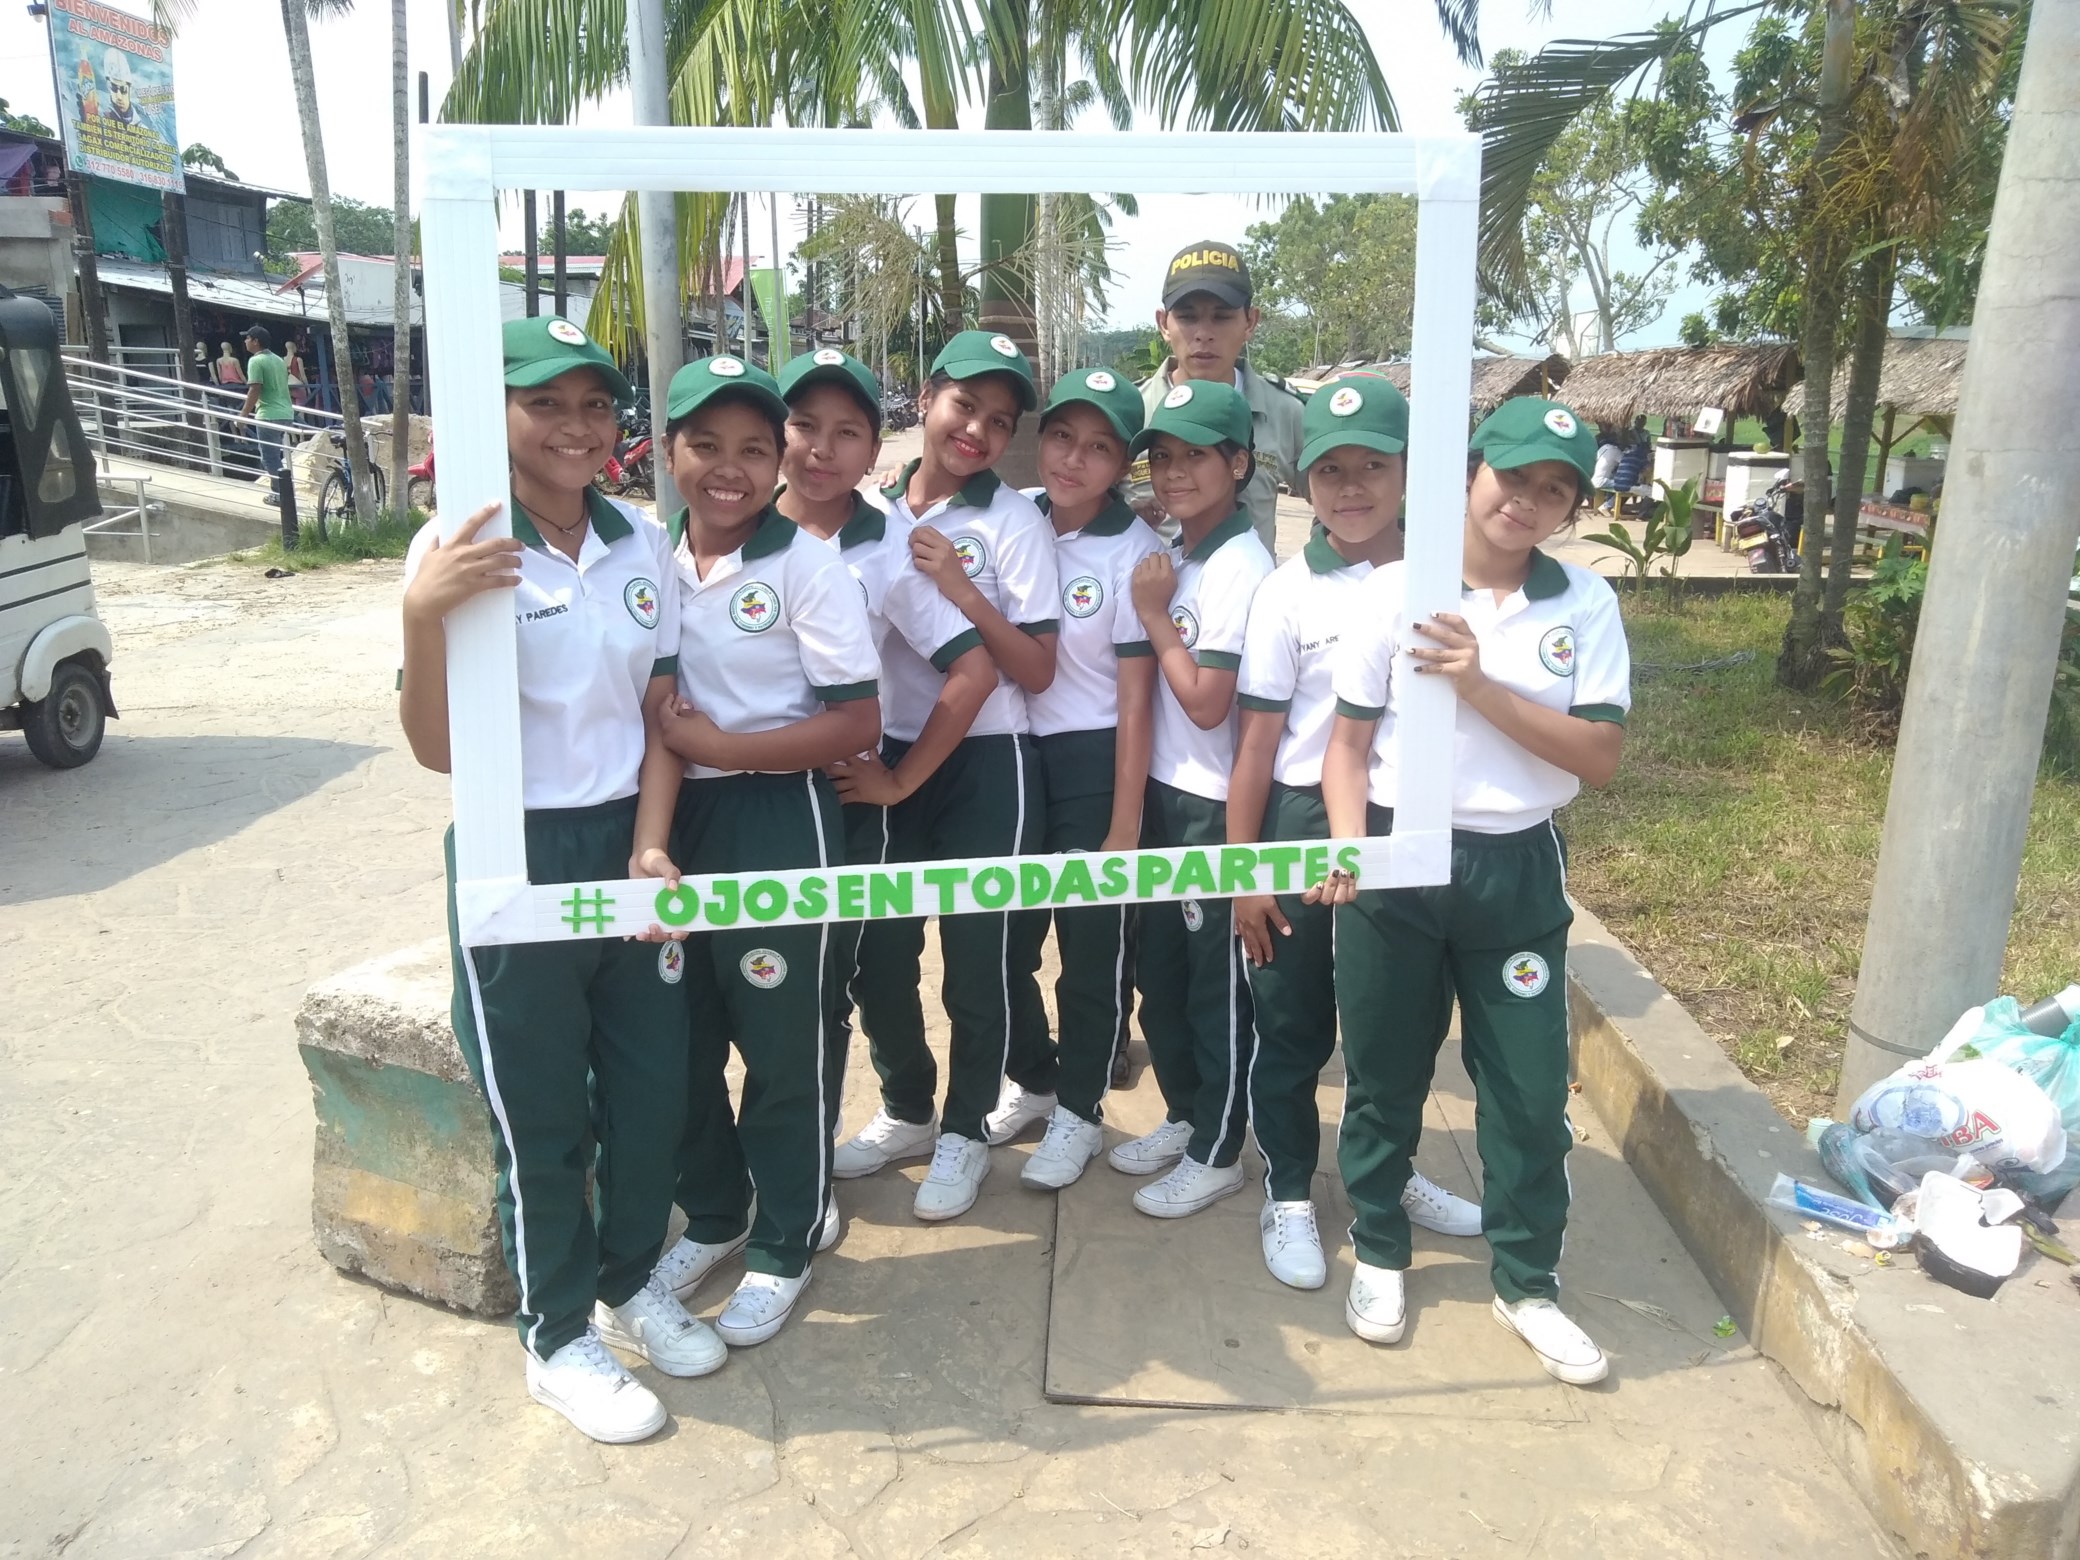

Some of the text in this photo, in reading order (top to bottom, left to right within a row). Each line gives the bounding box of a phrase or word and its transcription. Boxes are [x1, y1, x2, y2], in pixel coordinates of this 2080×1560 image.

[54, 0, 169, 47] BIENVENIDOS
[67, 18, 163, 63] AL AMAZONAS
[86, 113, 160, 139] POR QUE EL AMAZONAS
[103, 128, 113, 138] ES
[113, 130, 150, 147] TERRITORIO
[79, 144, 174, 174] DISTRIBUIDOR AUTORIZADO
[1170, 249, 1240, 276] POLICIA
[526, 603, 569, 622] PAREDES
